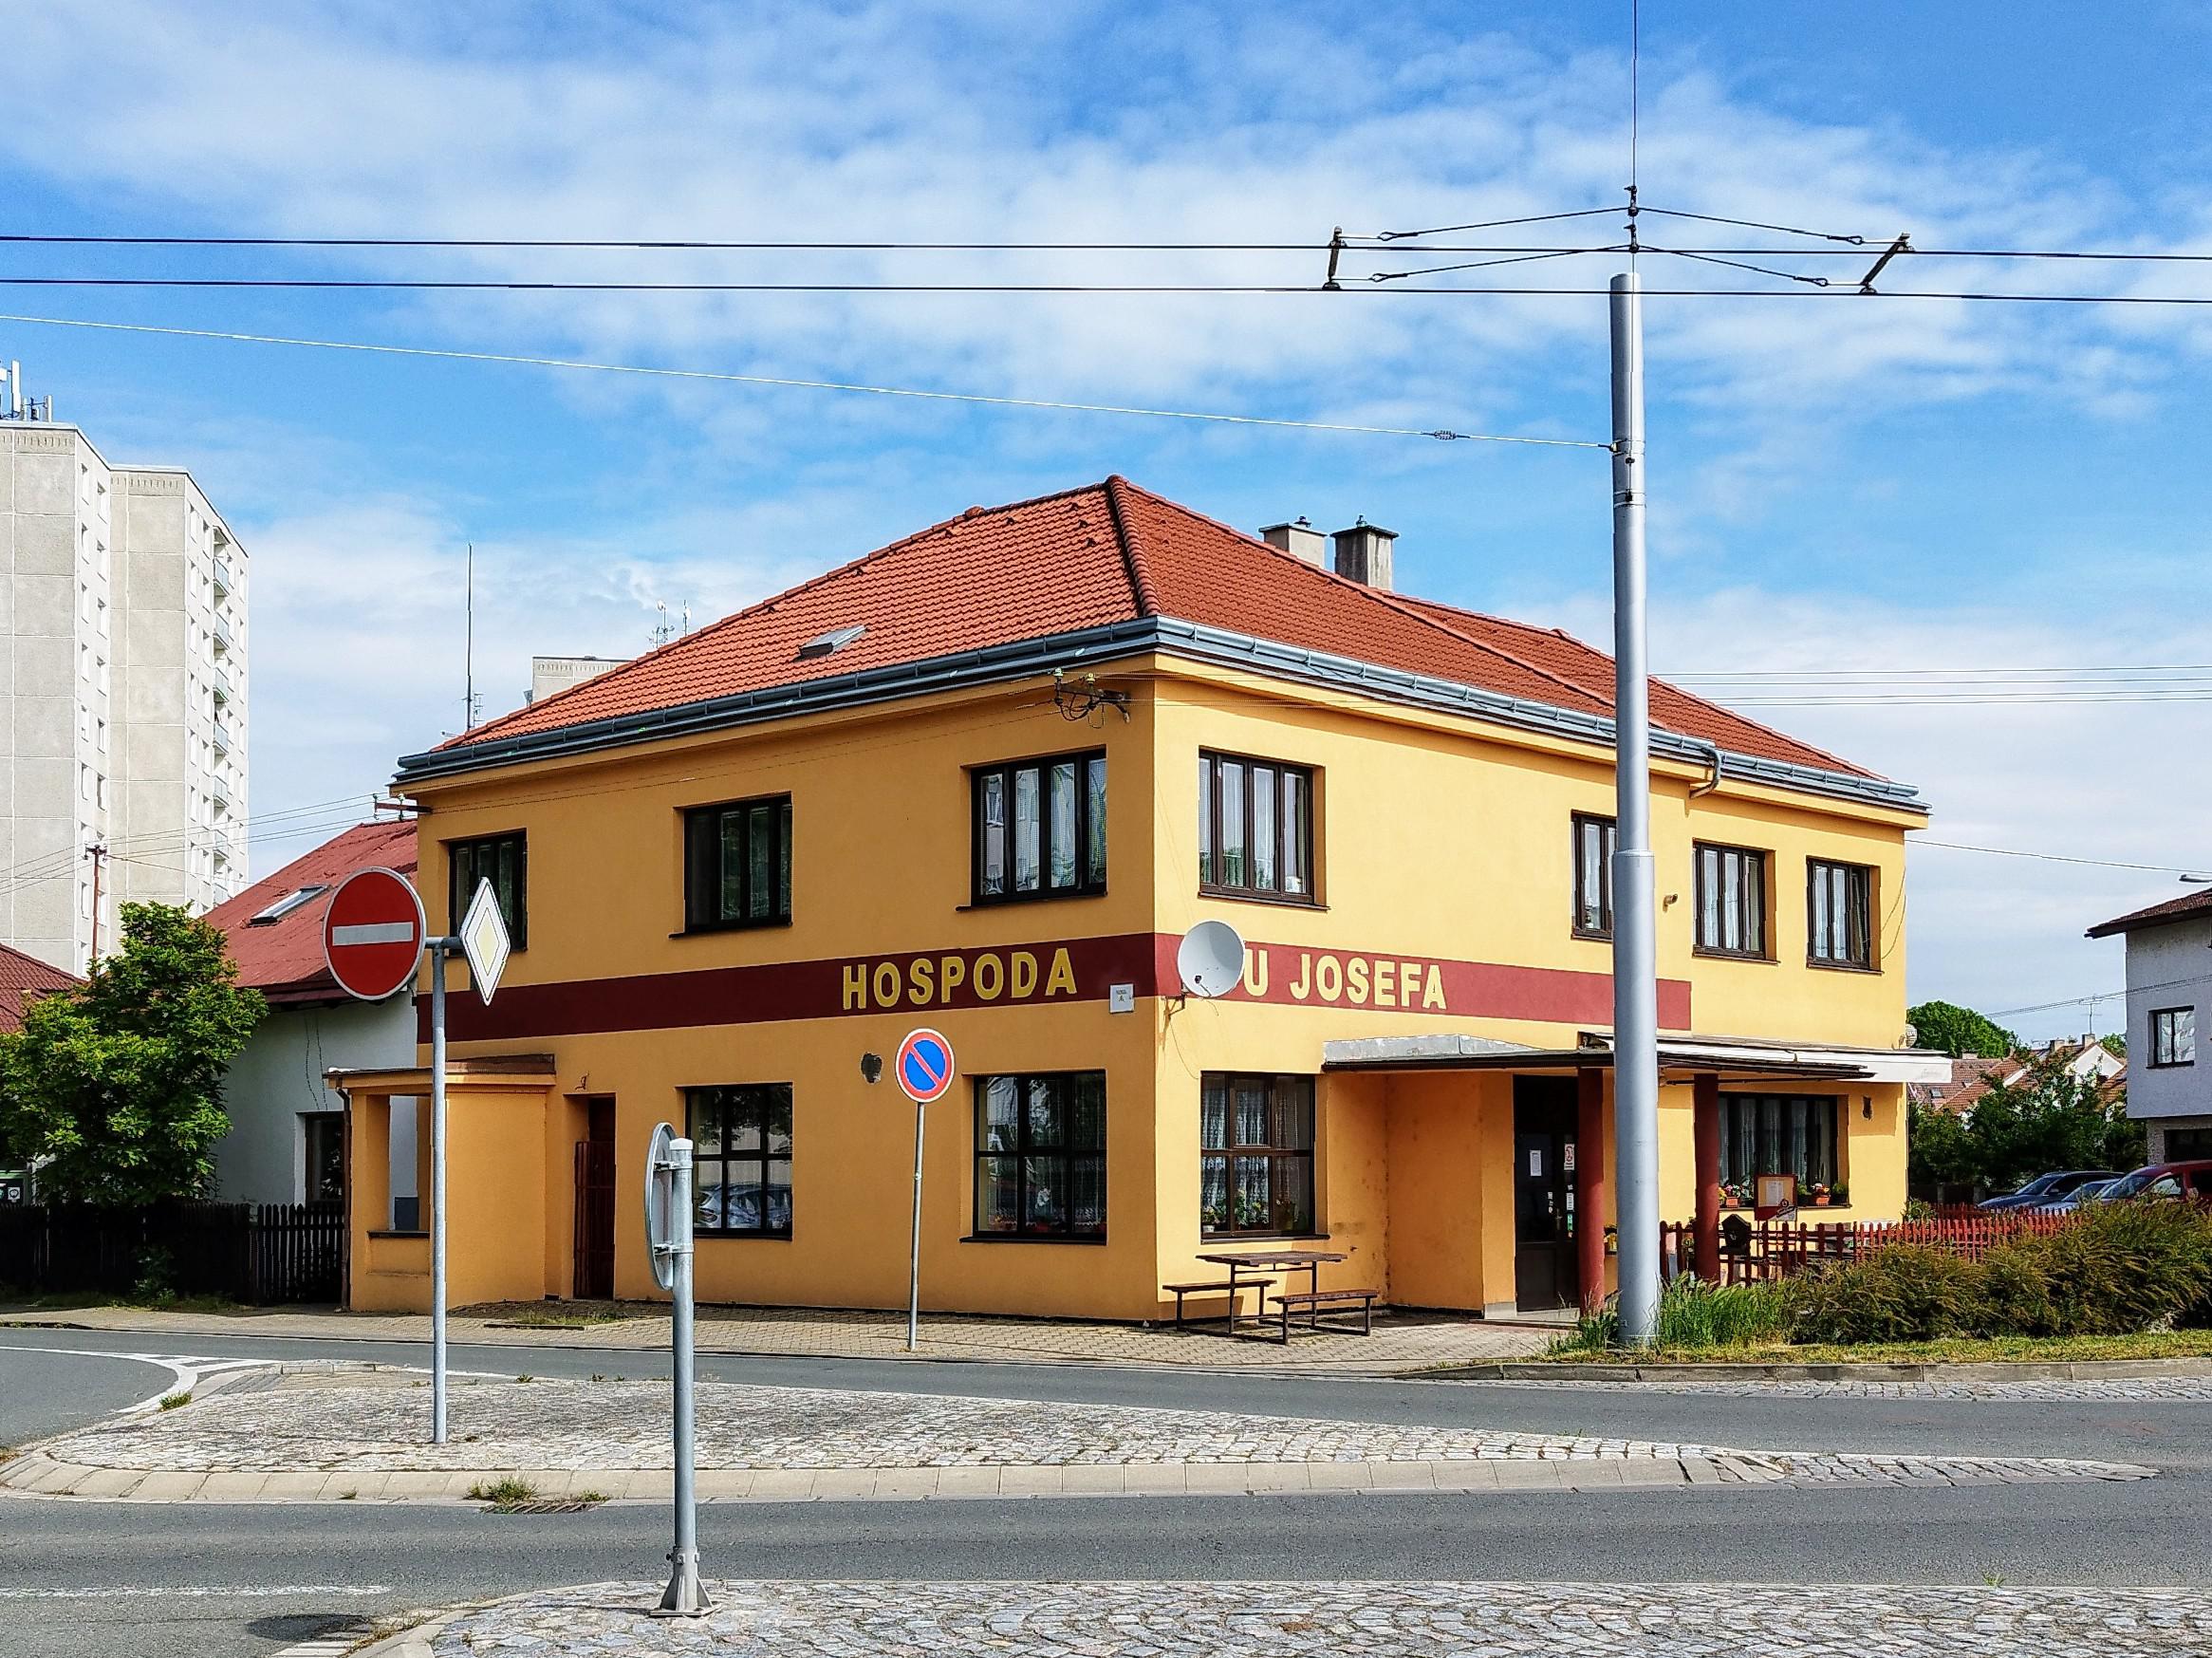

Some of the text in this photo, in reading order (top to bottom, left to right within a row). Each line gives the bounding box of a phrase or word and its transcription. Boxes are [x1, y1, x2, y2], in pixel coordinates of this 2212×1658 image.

[842, 947, 1077, 1011] HOSPODA
[1243, 948, 1448, 1011] U JOSEFA
